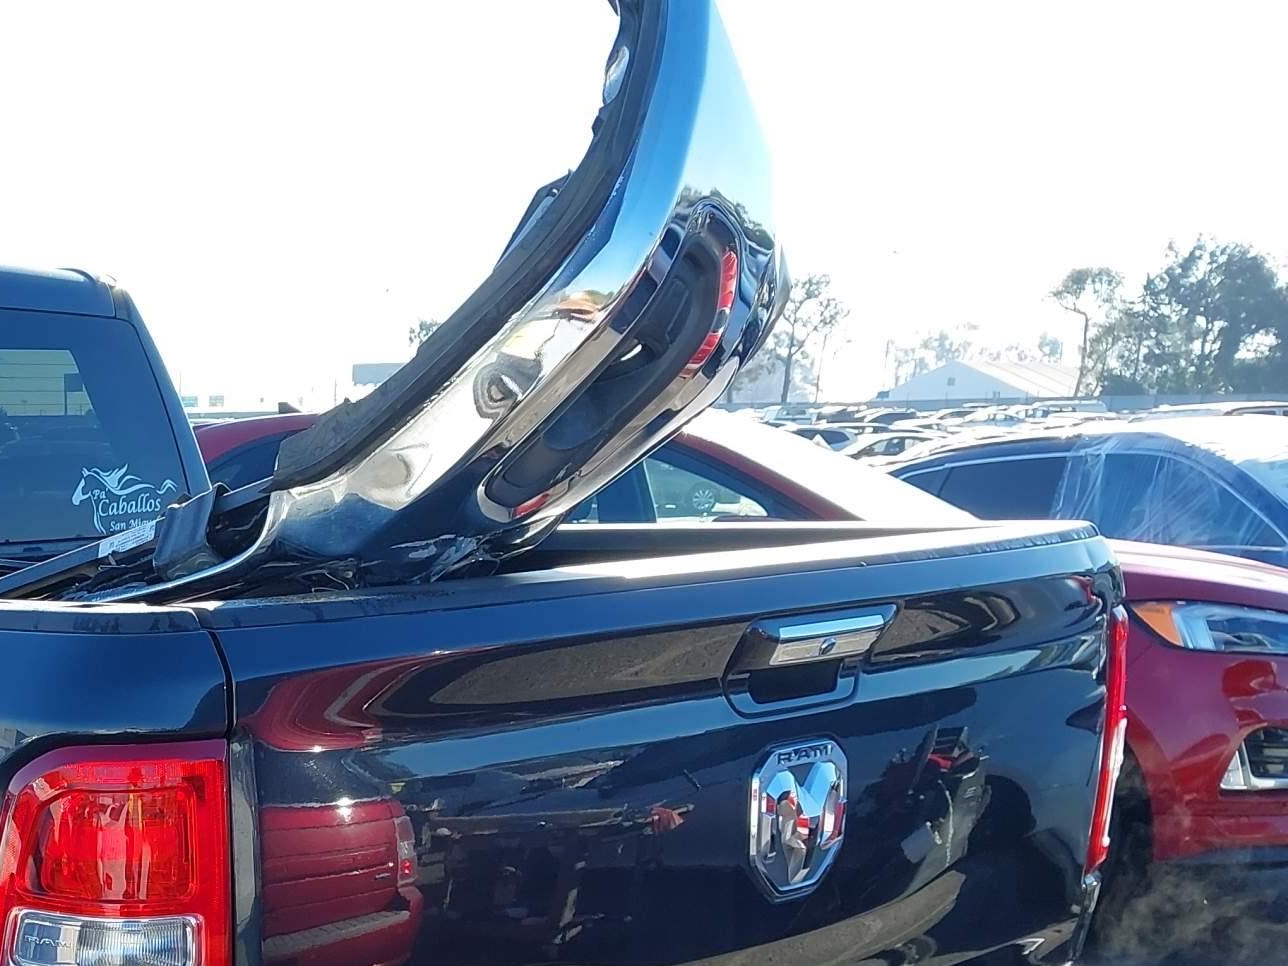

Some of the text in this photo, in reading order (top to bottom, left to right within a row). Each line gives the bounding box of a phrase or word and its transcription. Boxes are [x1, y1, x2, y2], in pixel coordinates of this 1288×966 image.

[98, 493, 161, 517] Caballos
[109, 520, 127, 532] San
[776, 744, 832, 766] RAM
